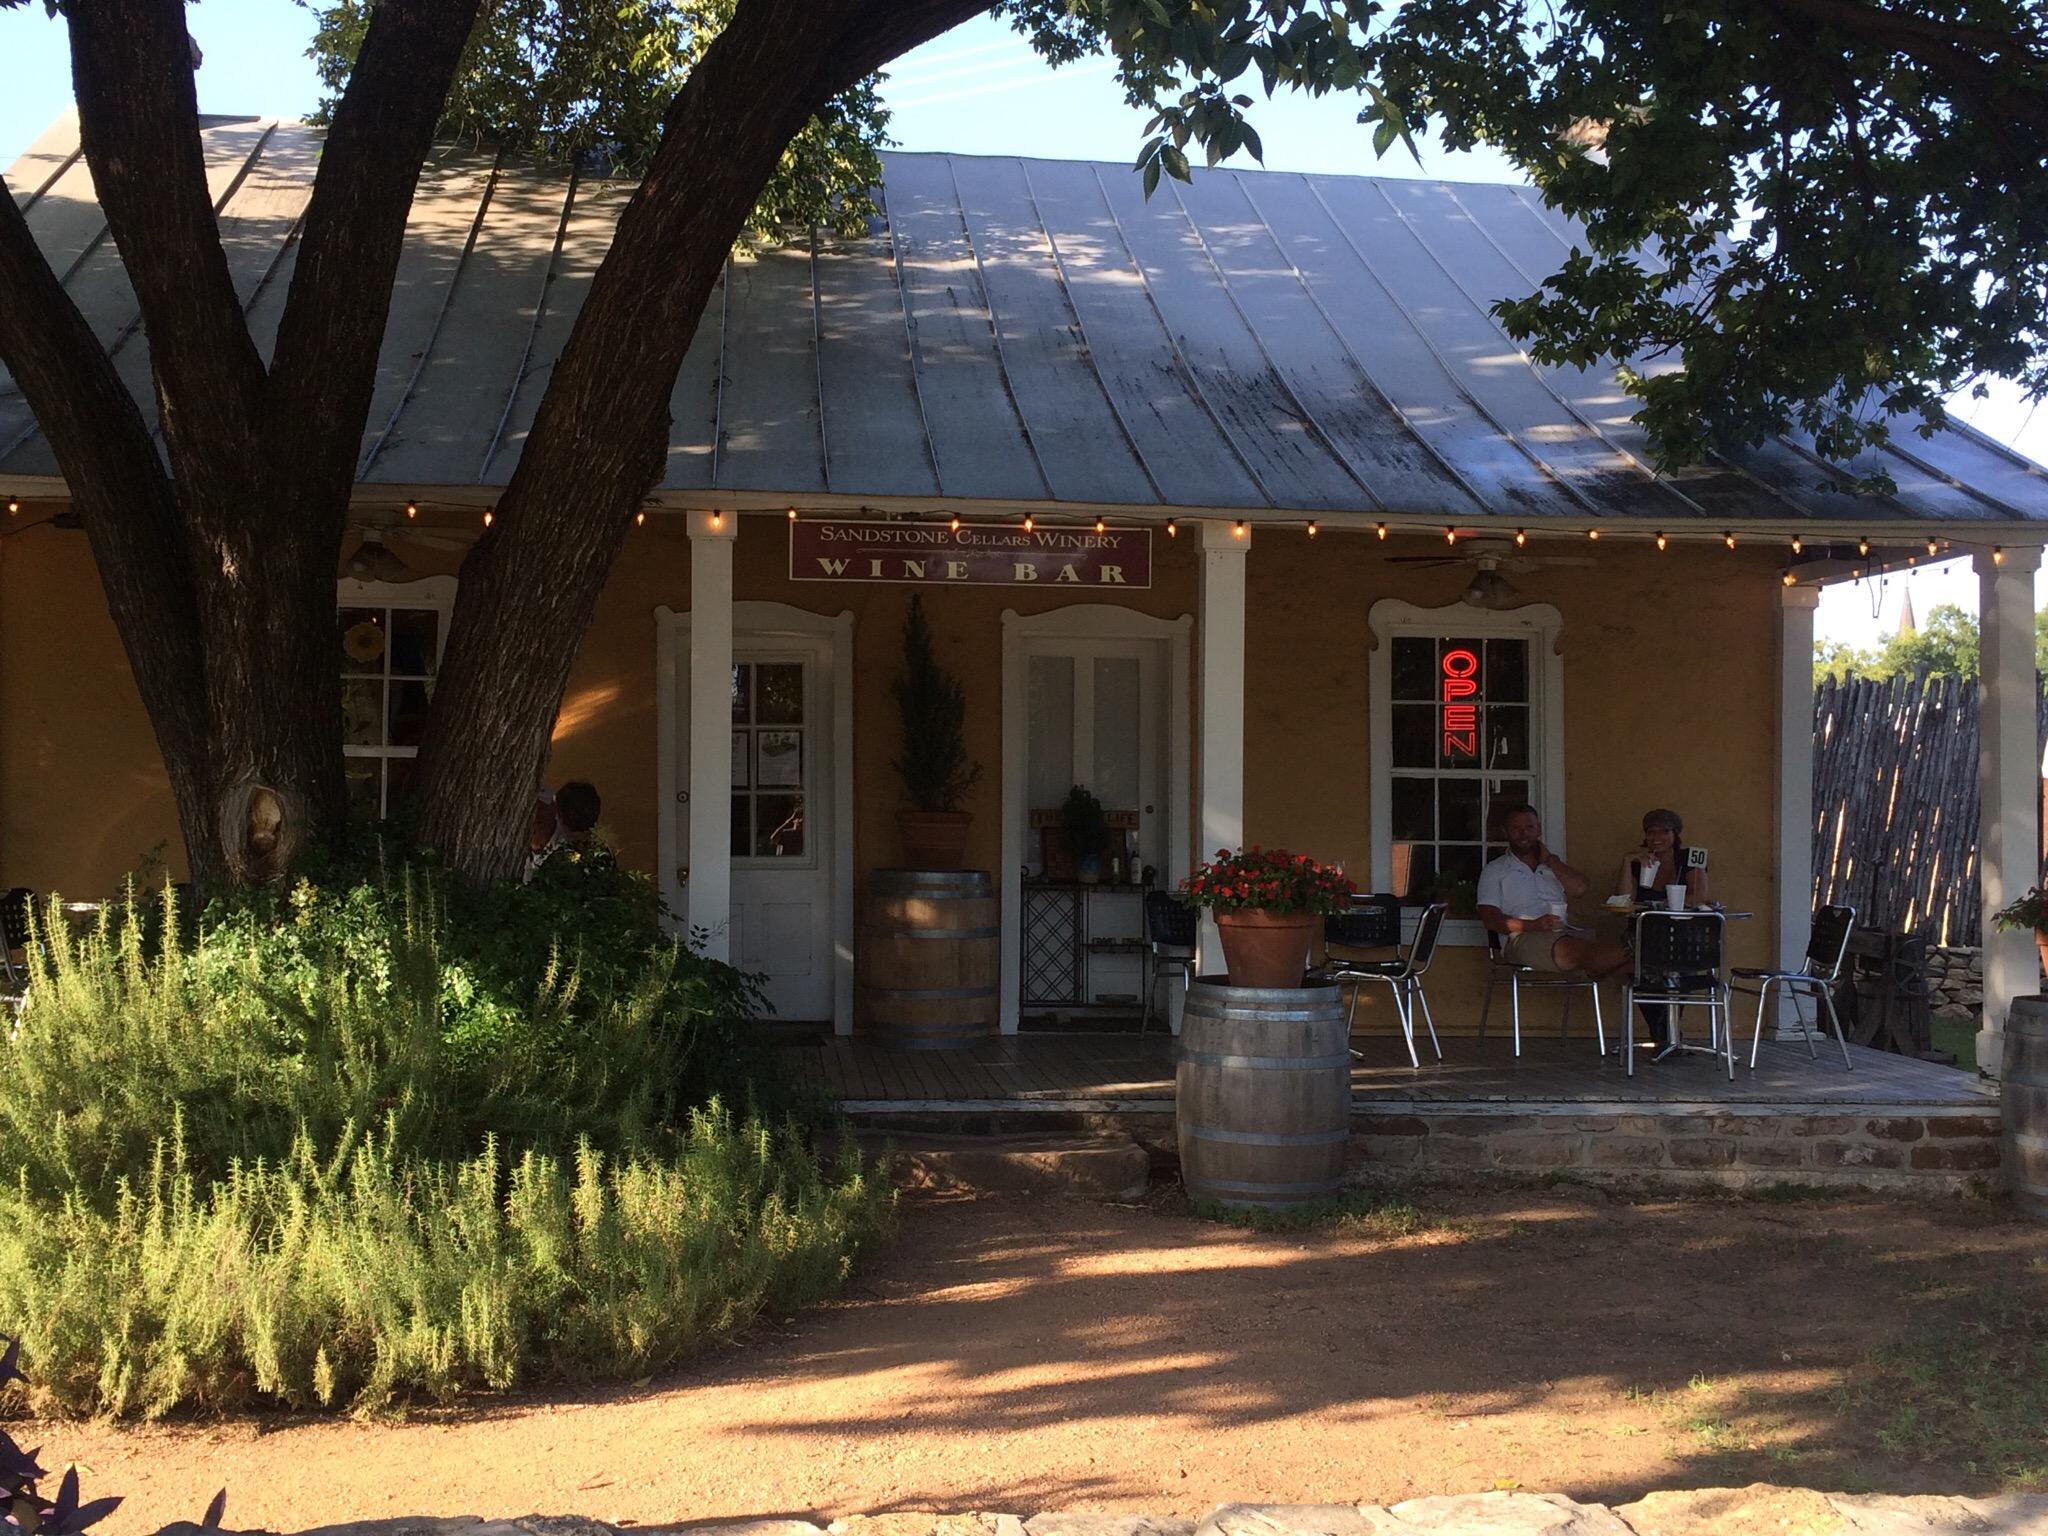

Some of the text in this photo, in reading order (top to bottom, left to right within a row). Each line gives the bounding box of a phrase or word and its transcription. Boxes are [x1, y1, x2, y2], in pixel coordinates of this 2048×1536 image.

[820, 525, 1123, 549] SANDSTONE CELLARS WINERY
[816, 557, 1126, 583] WINE BAR
[1443, 650, 1477, 757] OPEN
[1690, 850, 1705, 865] 50
